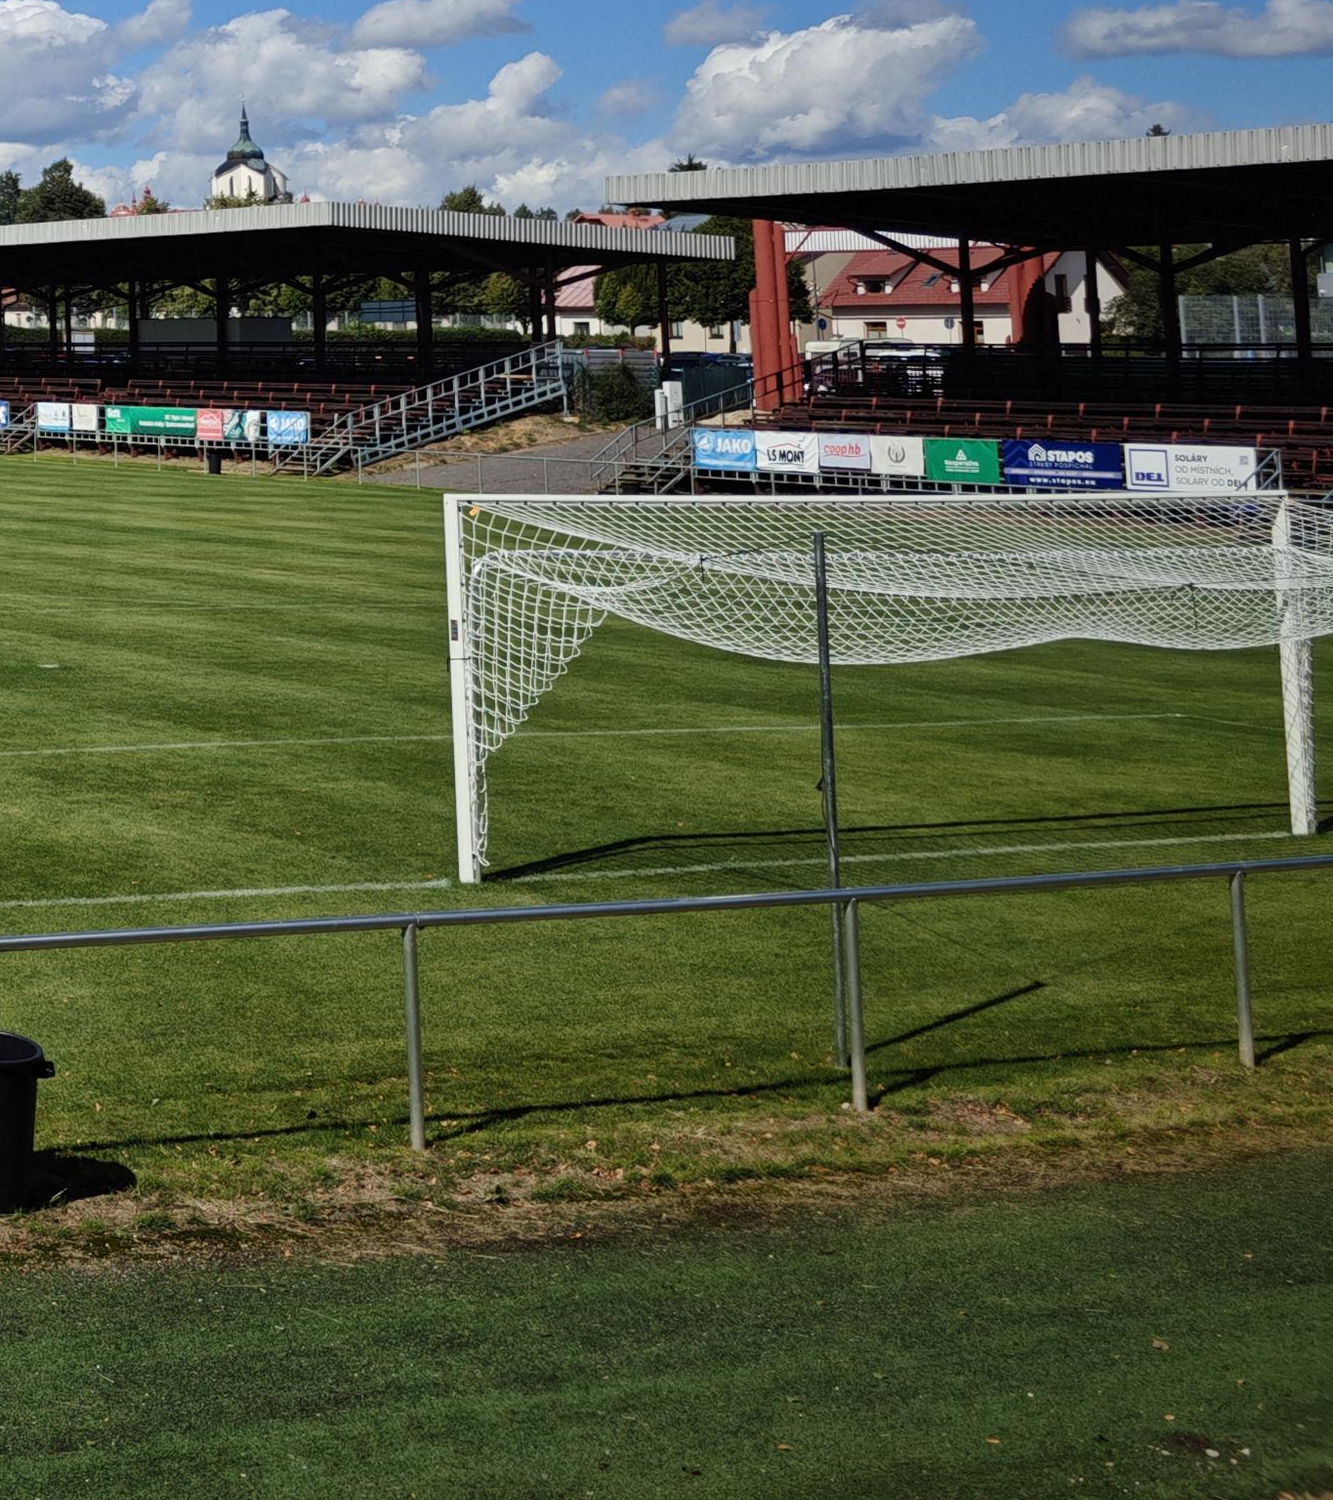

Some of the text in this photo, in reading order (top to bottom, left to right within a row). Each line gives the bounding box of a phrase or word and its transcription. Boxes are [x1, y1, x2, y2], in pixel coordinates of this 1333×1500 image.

[716, 437, 752, 455] JAKO
[779, 450, 805, 463] MONT
[1048, 451, 1094, 463] STAPOS
[1175, 454, 1208, 463] SOLÁRY
[1190, 466, 1234, 476] MÍSTNÍCH,
[1030, 477, 1096, 486] www.stapos.eu
[1135, 472, 1165, 482] DEL
[1176, 477, 1209, 486] SOLÁRY
[1211, 479, 1225, 487] OD
